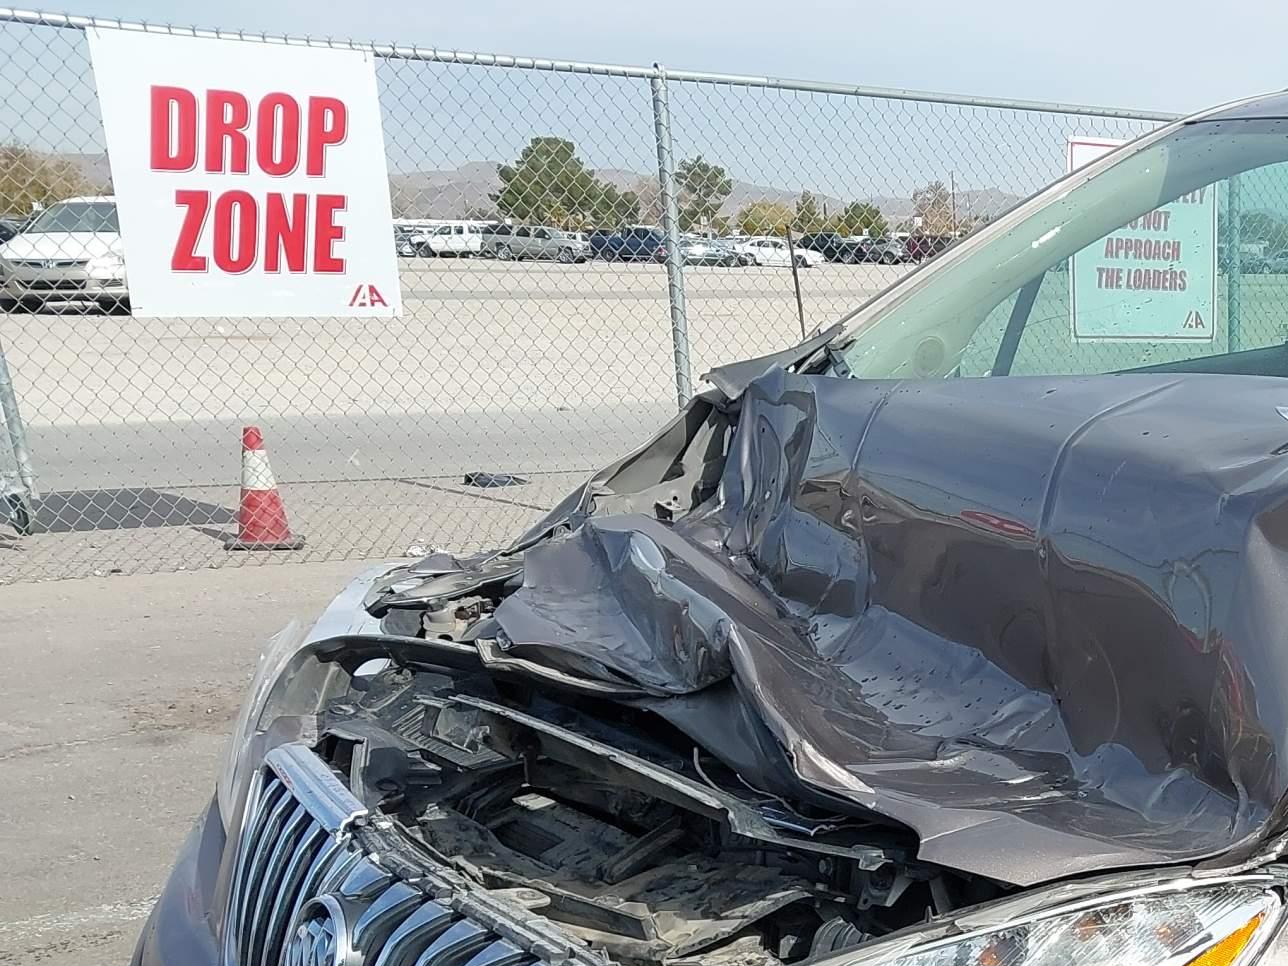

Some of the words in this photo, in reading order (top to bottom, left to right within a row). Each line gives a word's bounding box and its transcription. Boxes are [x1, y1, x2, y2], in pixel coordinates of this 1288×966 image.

[150, 84, 348, 178] DROP
[171, 189, 348, 274] ZONE
[1142, 210, 1171, 232] NOT
[1104, 237, 1182, 262] APPROACH
[1096, 267, 1123, 289] THE
[1125, 268, 1188, 292] LOADERS
